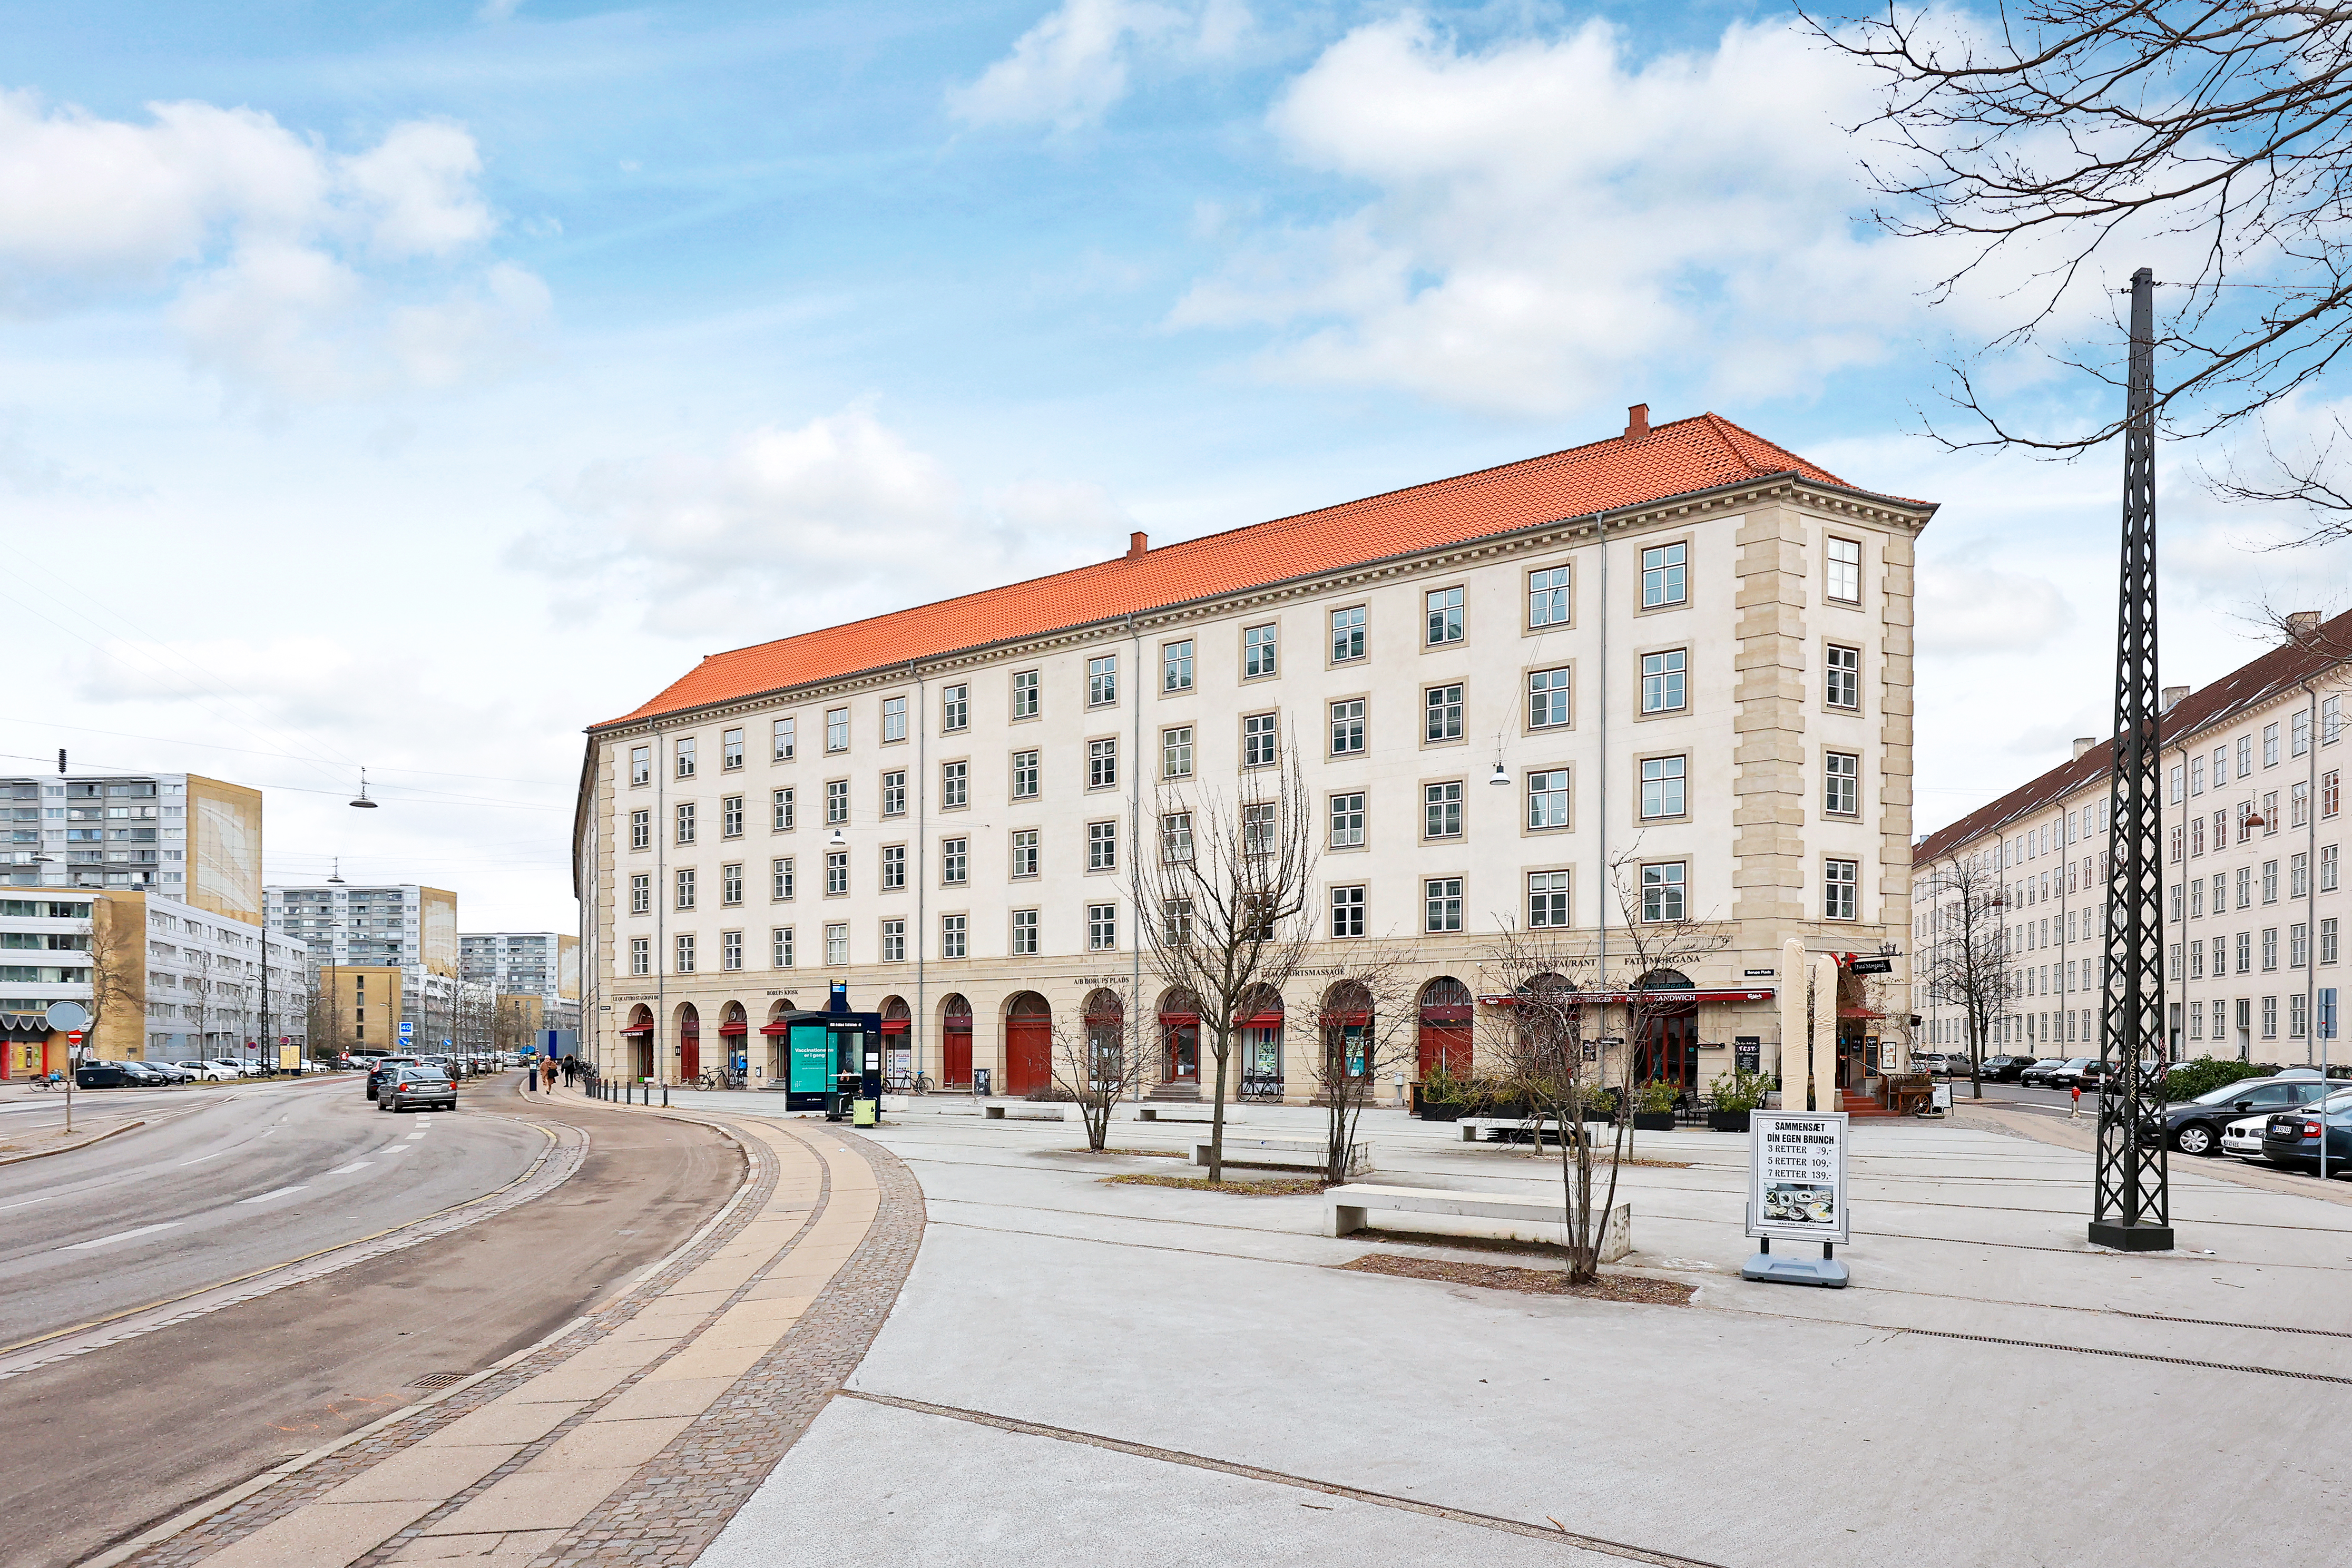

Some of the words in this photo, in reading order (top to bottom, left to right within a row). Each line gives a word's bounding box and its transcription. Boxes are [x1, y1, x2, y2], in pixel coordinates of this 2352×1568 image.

[1775, 1122, 1825, 1132] SAMMENSÆT
[1782, 1134, 1801, 1143] EGEN
[1804, 1135, 1834, 1144] BRUNCH
[1775, 1145, 1807, 1154] RETTER
[1775, 1157, 1807, 1166] RETTER
[1812, 1159, 1831, 1168] 109,-
[1775, 1169, 1807, 1179] RETTER
[1811, 1171, 1831, 1180] 139,-
